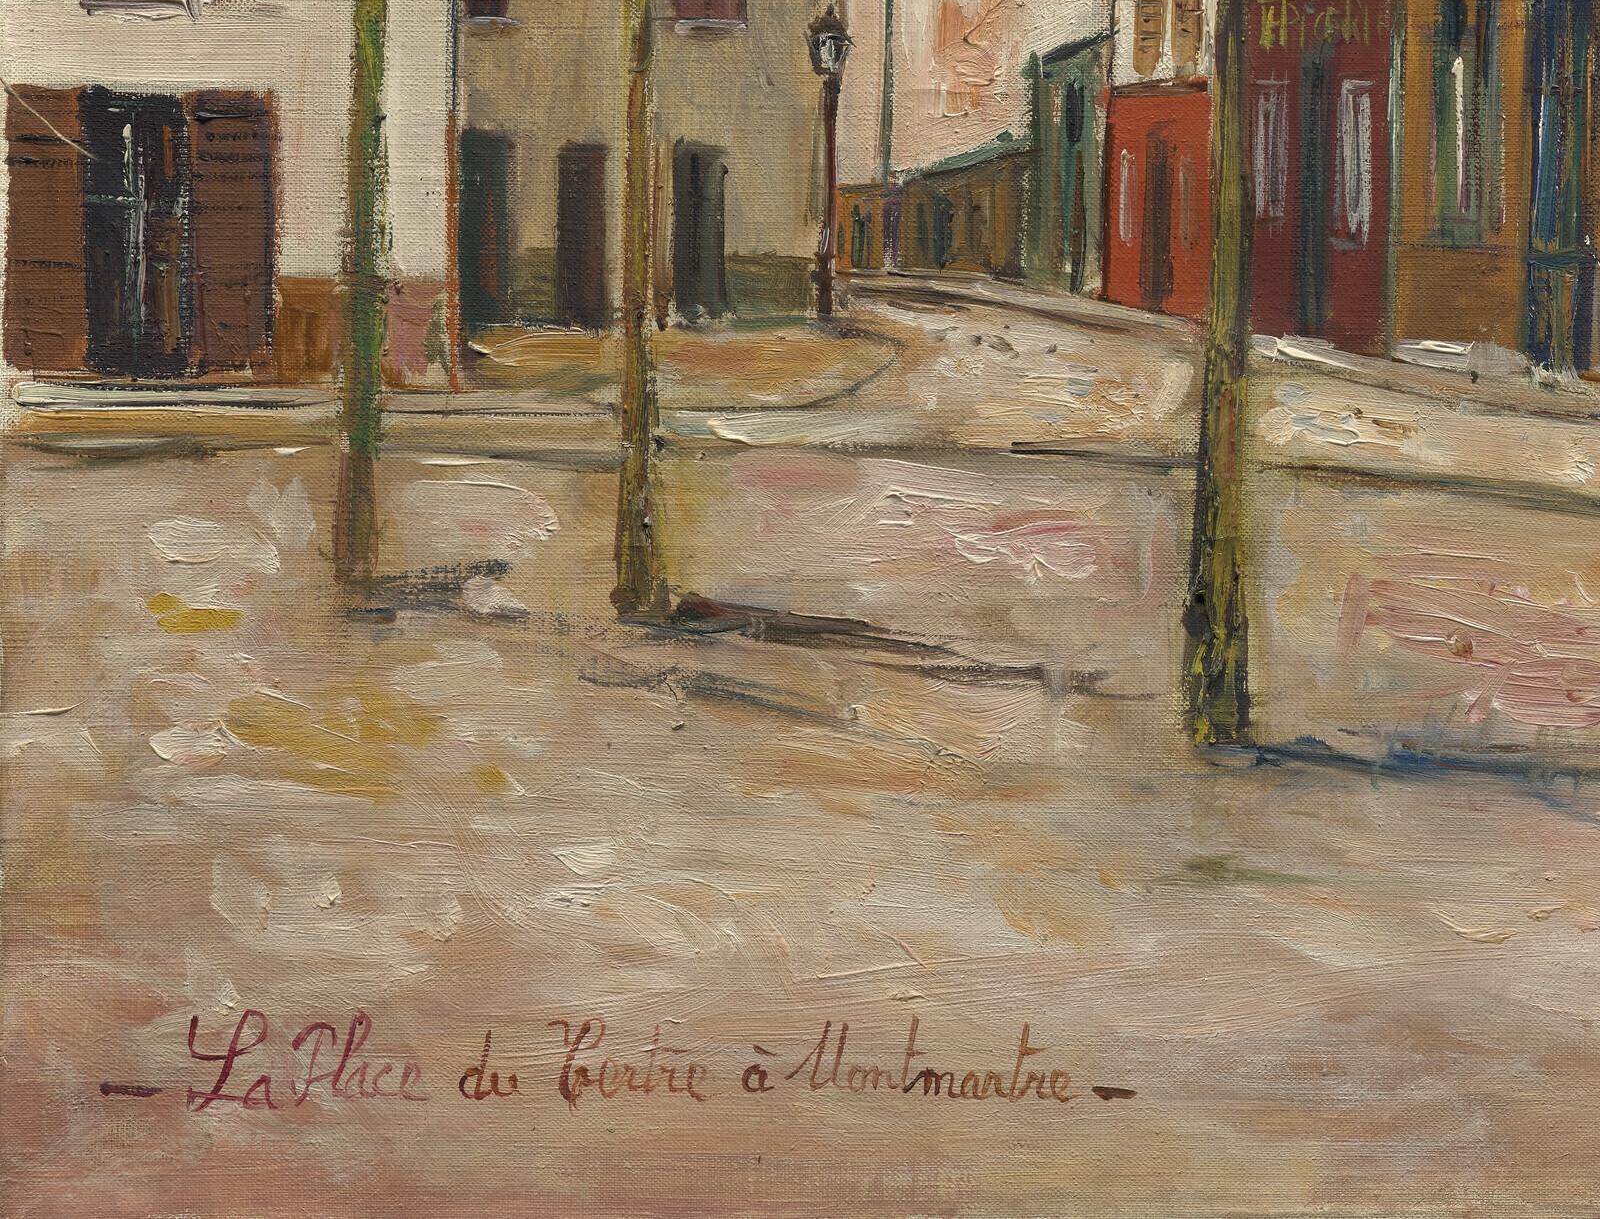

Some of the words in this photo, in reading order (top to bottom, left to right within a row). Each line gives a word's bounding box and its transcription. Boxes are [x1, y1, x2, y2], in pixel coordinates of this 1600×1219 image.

[186, 1009, 280, 1113] La
[291, 1009, 430, 1107] Place
[458, 1028, 523, 1102] du
[547, 1017, 722, 1115] Tertre
[741, 1043, 776, 1094] à
[784, 1014, 1084, 1105] Montmartre
